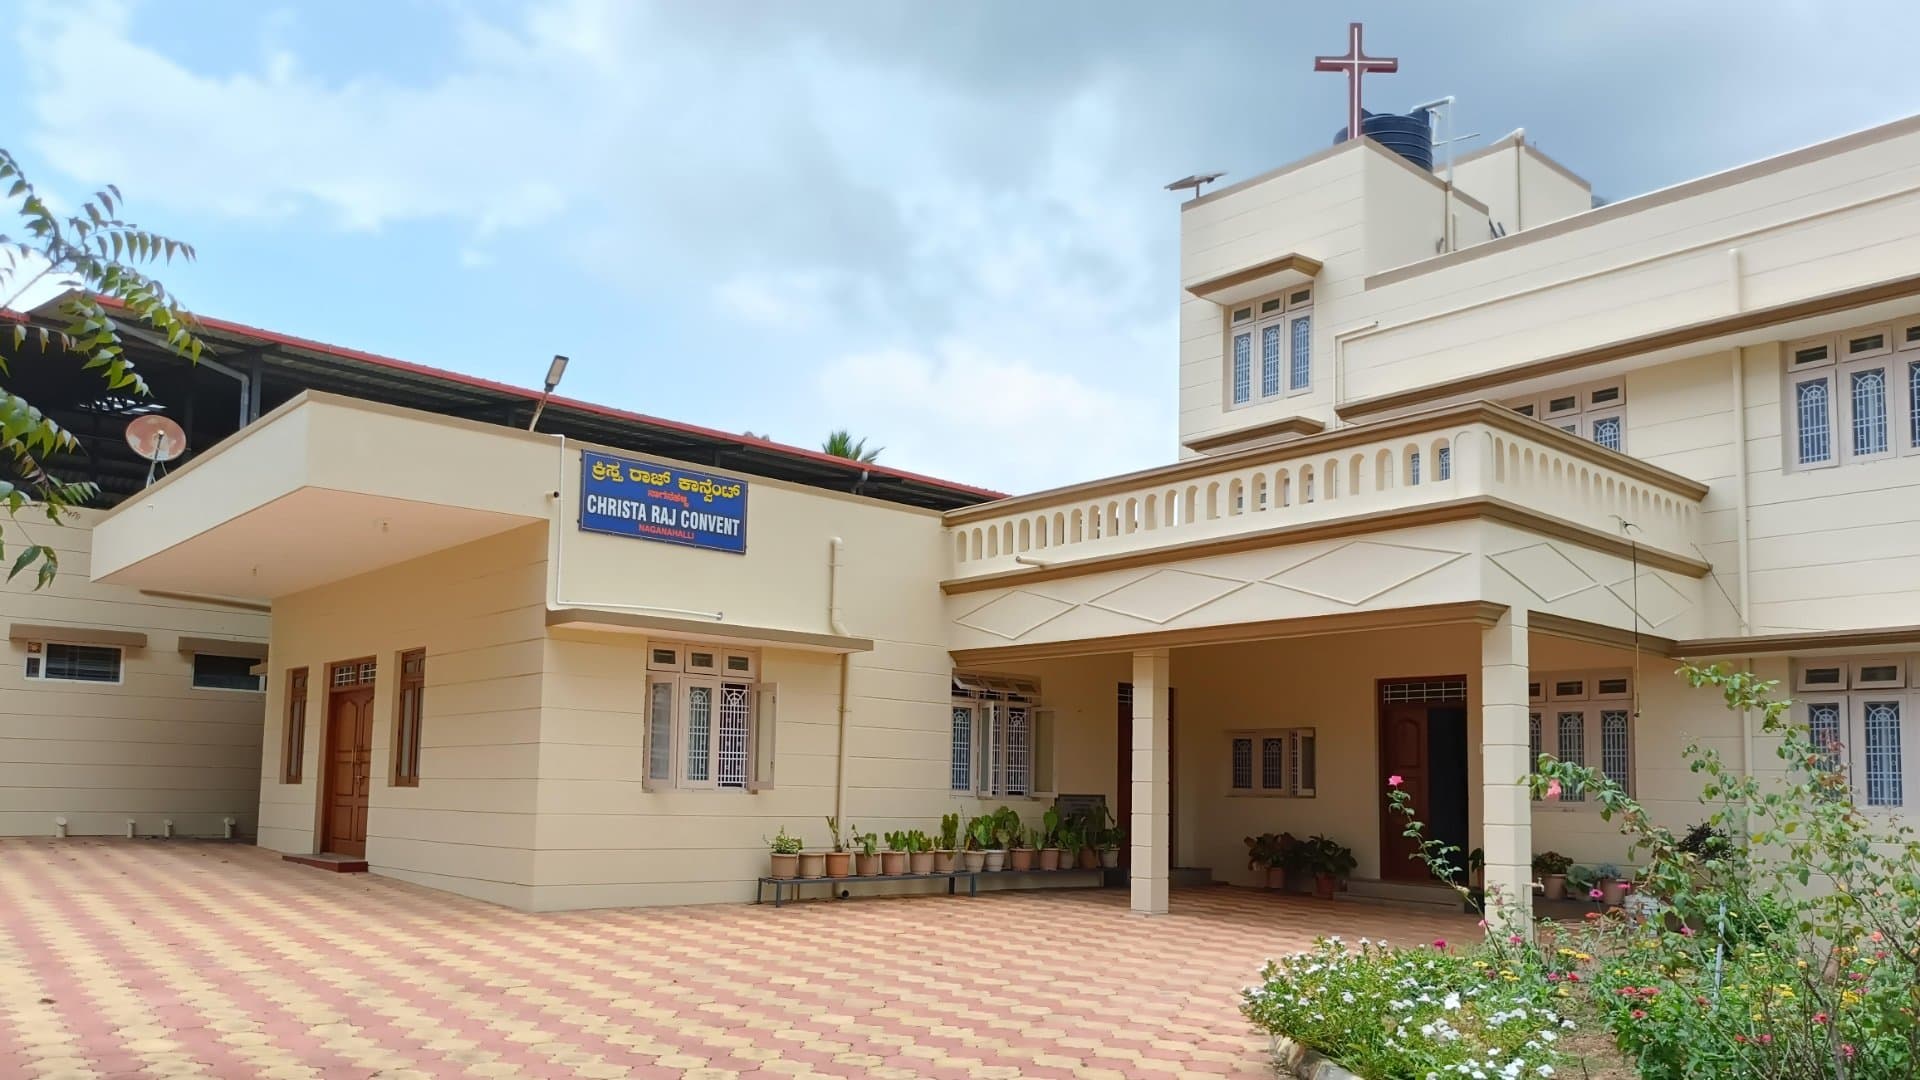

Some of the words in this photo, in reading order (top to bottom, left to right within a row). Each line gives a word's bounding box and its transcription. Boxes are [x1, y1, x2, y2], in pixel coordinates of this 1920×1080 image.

[587, 494, 647, 521] CHRISTA
[651, 505, 676, 526] RAJ
[680, 511, 740, 537] CONVENT
[638, 524, 695, 539] NAGANAHALLI
